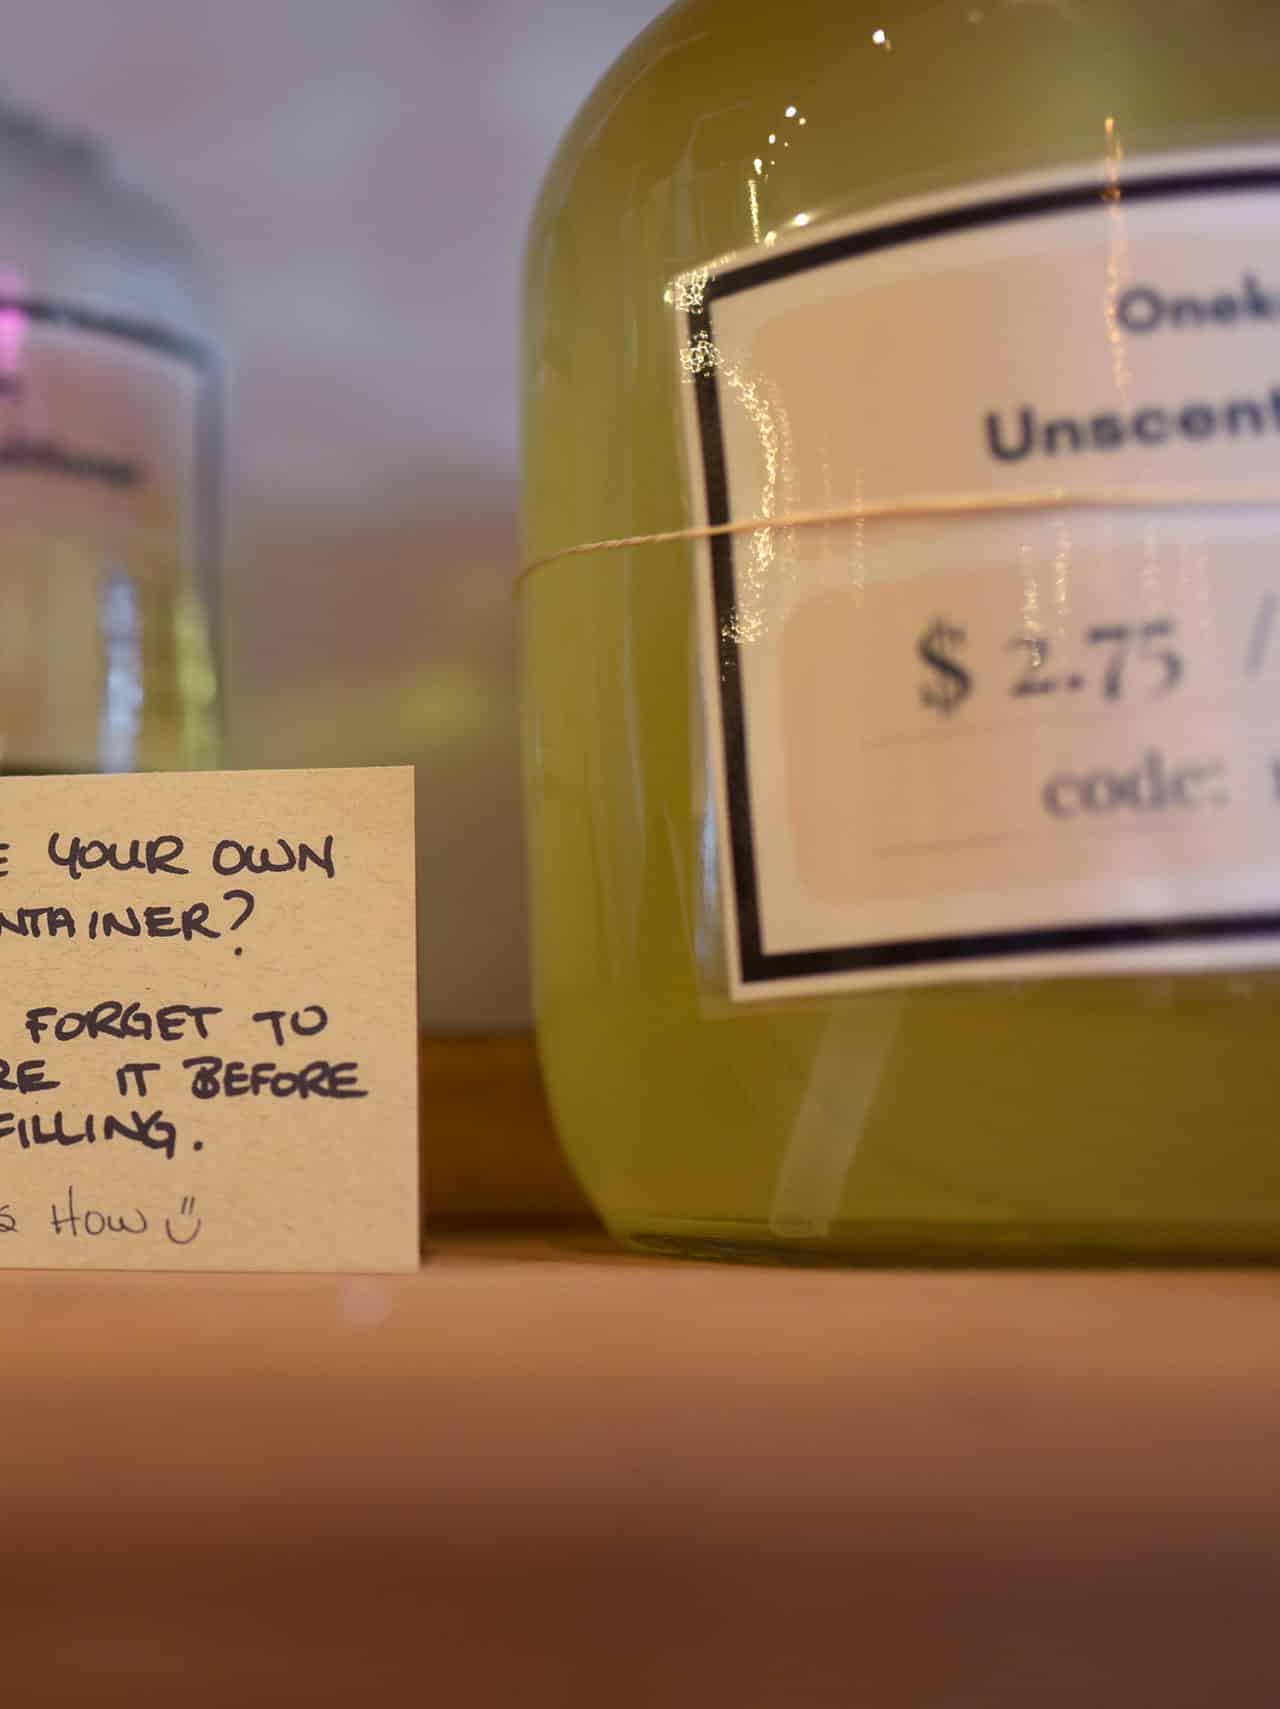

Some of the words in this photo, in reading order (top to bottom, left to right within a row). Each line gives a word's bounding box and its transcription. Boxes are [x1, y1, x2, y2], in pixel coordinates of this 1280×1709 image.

[1009, 618, 1184, 704] 2.75
[47, 831, 190, 880] YOUR
[212, 834, 336, 879] OWN
[24, 1000, 223, 1045] FORGET
[251, 1004, 329, 1047] TO
[115, 1062, 161, 1098] IT
[181, 1055, 369, 1100] BEFORE
